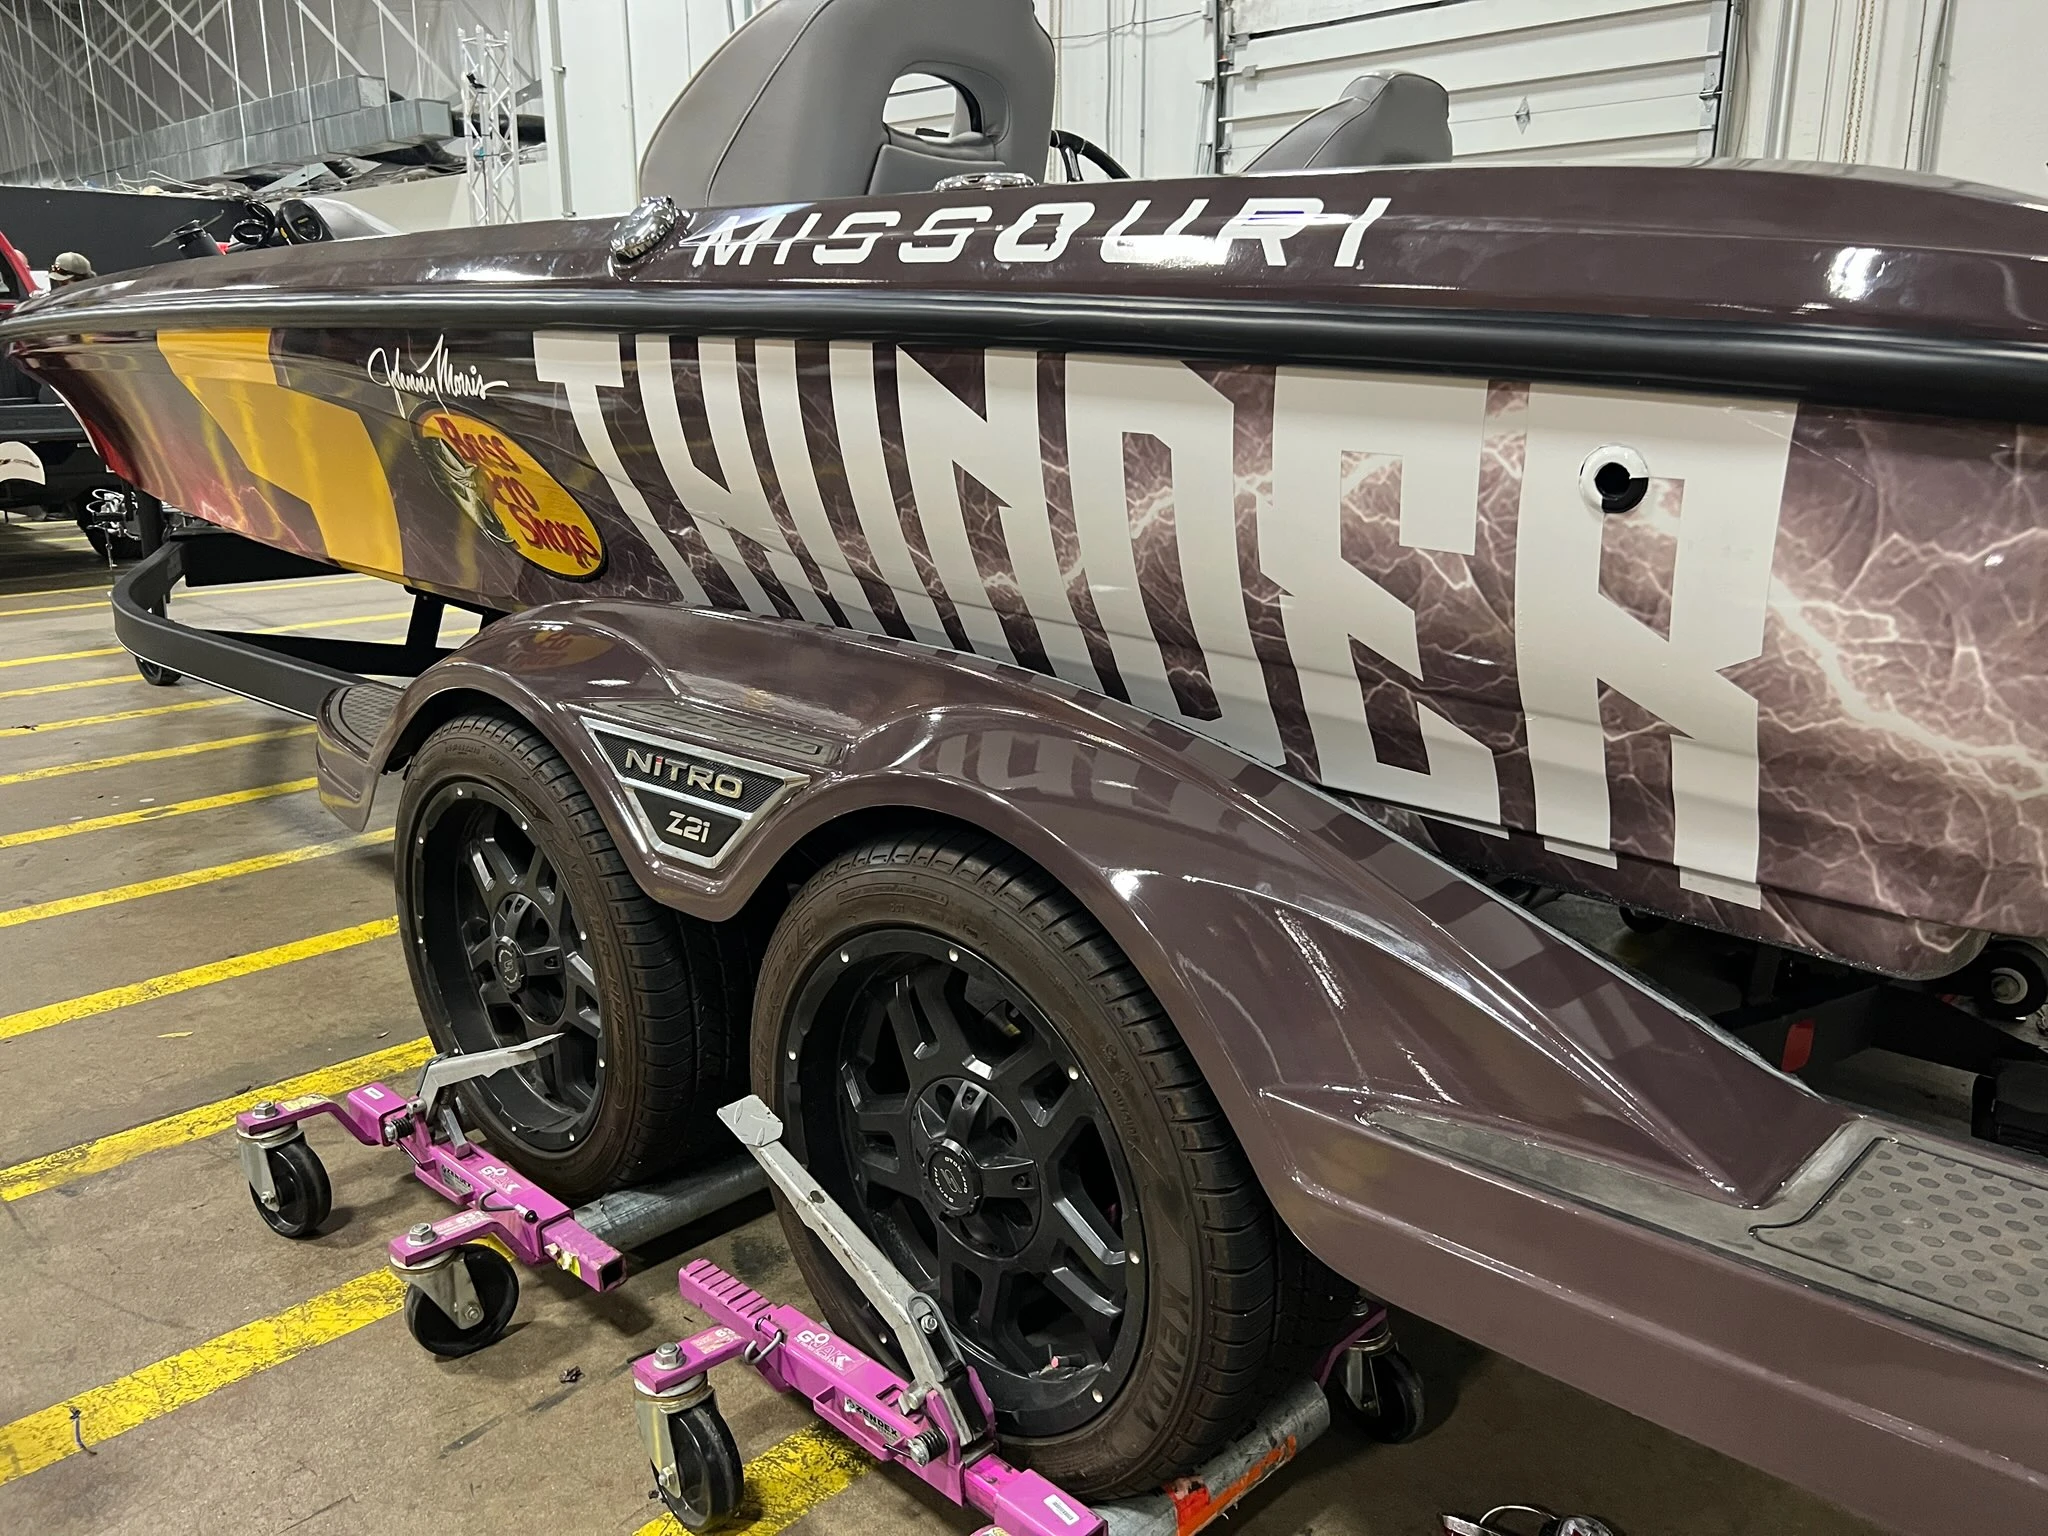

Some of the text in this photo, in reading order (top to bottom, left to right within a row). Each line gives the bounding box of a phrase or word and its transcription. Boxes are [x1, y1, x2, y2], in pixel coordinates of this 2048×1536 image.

[692, 196, 1392, 270] MISSOURI
[434, 416, 522, 475] Bass
[507, 502, 601, 569] Shops
[533, 329, 1798, 911] THUNDER
[625, 748, 744, 799] NITRO
